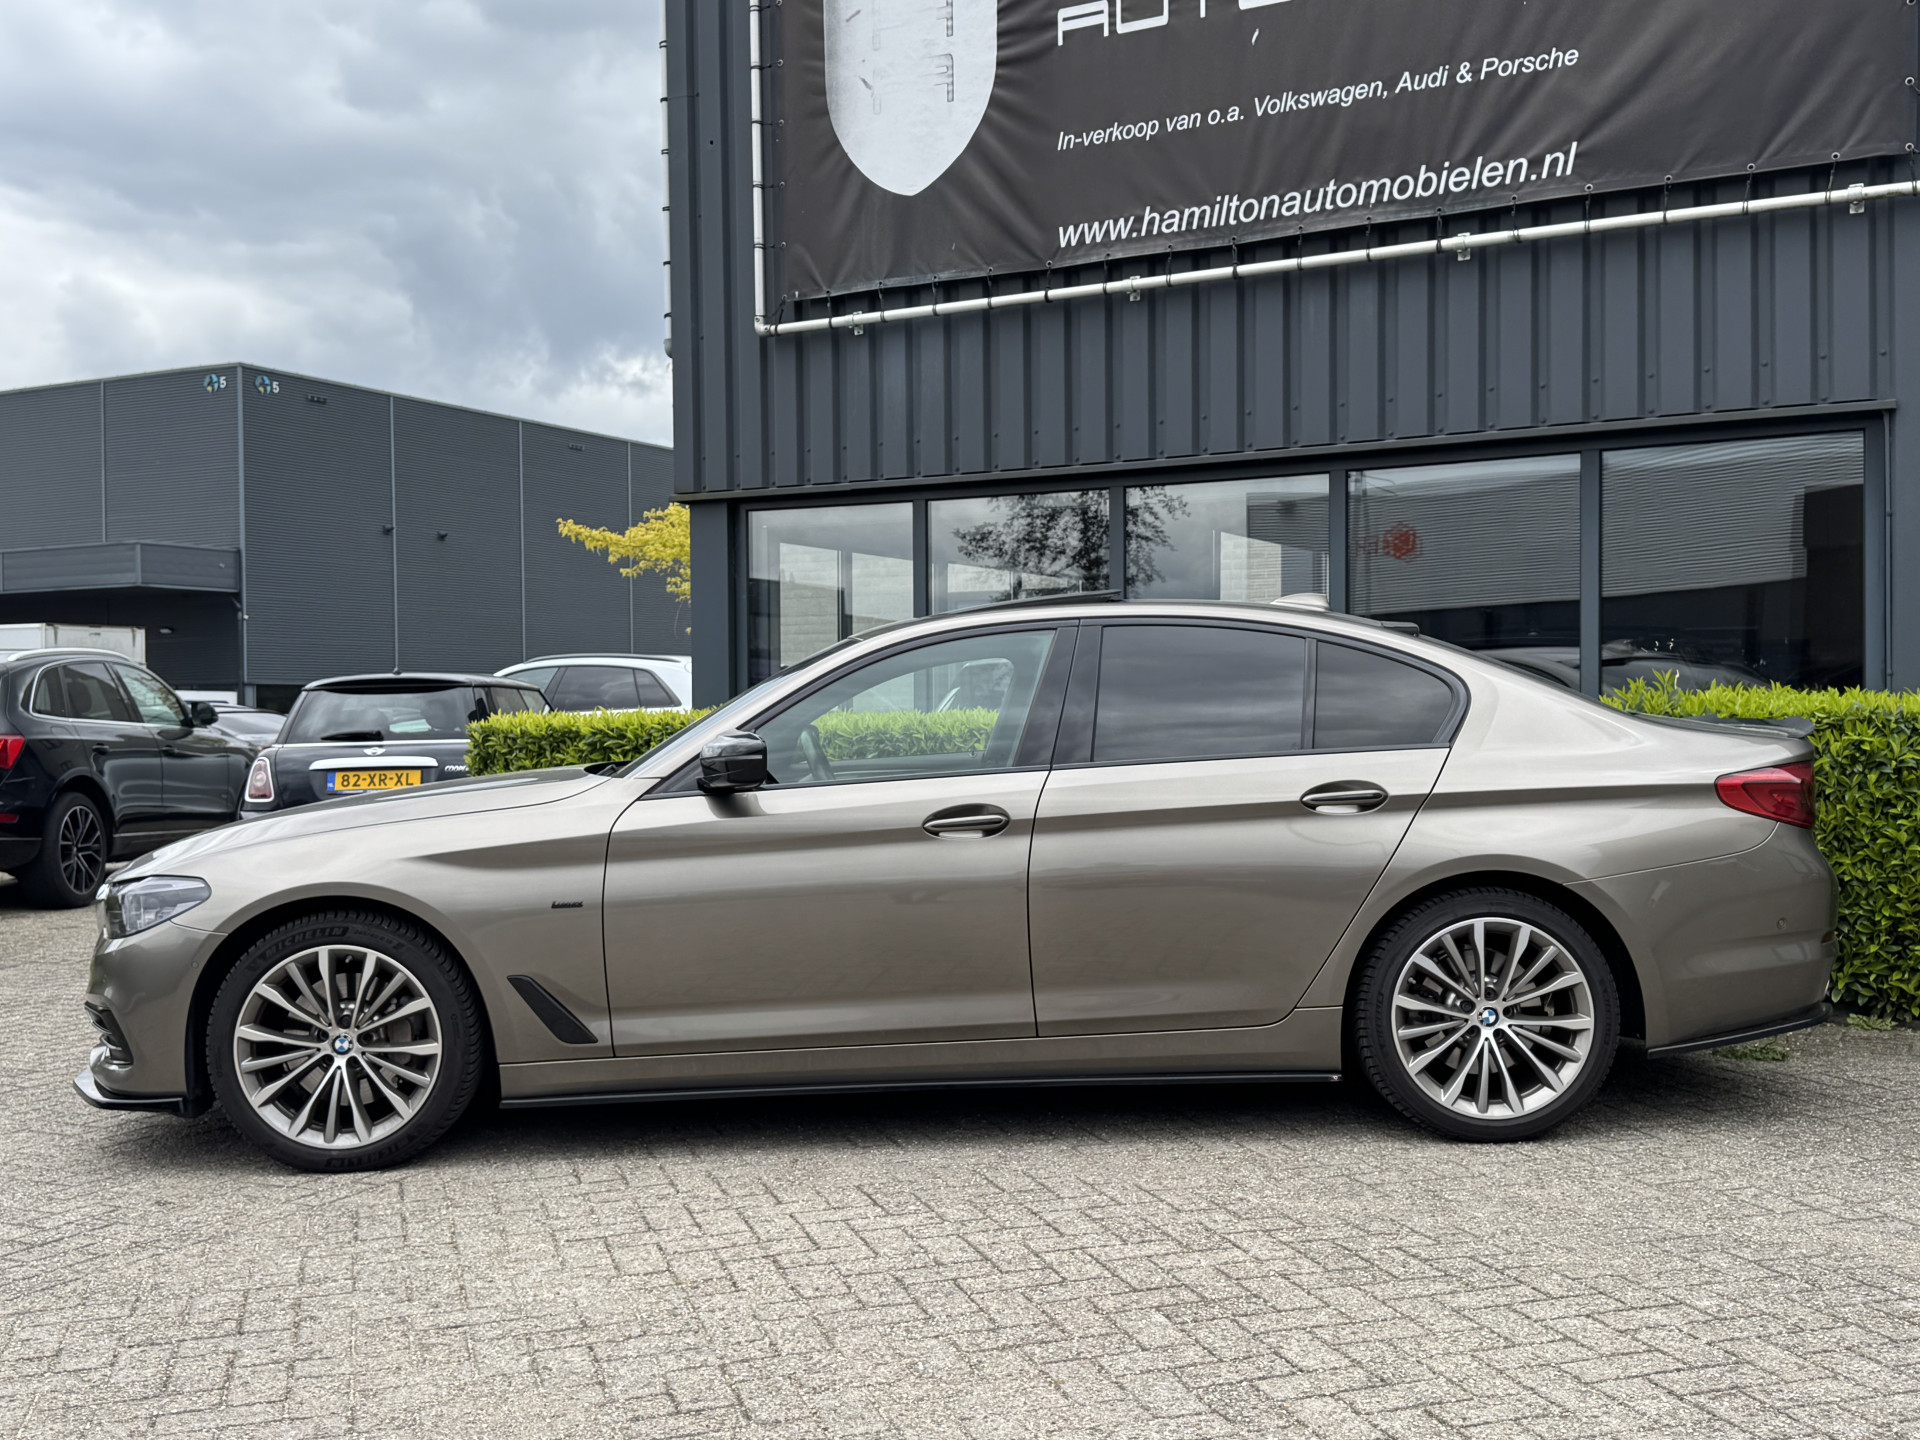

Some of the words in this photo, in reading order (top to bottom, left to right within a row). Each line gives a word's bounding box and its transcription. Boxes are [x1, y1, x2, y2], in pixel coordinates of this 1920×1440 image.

[1057, 122, 1160, 151] In-verkoop
[1165, 112, 1202, 133] van
[1207, 105, 1245, 126] o.a.
[1254, 80, 1389, 117] Volkswagen,
[1394, 65, 1450, 95] Audi
[1455, 61, 1473, 84] &
[1480, 47, 1580, 81] Porsche
[1057, 141, 1578, 249] www.hamiltonautomobielen.nl
[219, 376, 227, 389] 5
[272, 381, 280, 394] 5
[340, 772, 415, 788] 82-XR-XL
[265, 927, 344, 958] MICHELIN
